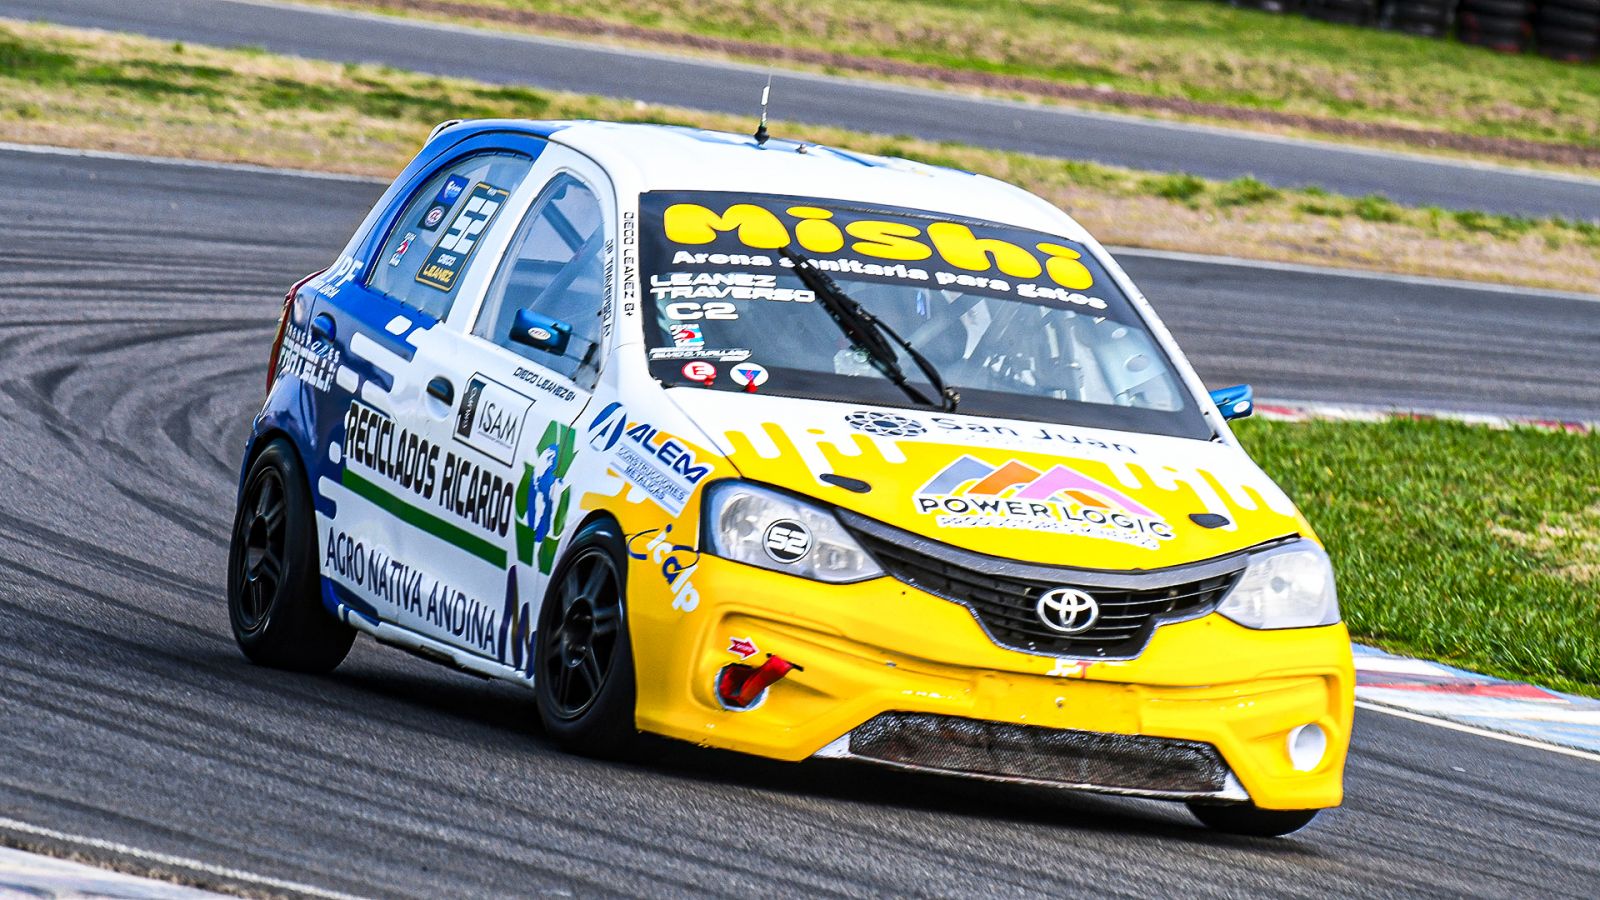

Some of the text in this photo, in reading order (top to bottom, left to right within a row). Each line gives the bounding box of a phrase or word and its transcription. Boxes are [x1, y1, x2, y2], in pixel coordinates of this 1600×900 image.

[663, 203, 1094, 290] Mishi
[623, 249, 635, 299] LEANEZ
[650, 272, 777, 287] LEANEZ
[650, 286, 816, 303] TRAVERSO
[672, 250, 1108, 310] Arena snitaria para gatos
[665, 302, 739, 320] C2
[691, 365, 706, 376] E
[478, 400, 519, 445] ISAM
[931, 417, 1018, 437] San
[1032, 429, 1137, 454] Juan
[345, 401, 440, 500] RECICLADOS
[439, 453, 514, 537] RICARDO
[626, 423, 709, 484] ALEM
[918, 497, 1048, 517] POWER
[1062, 505, 1174, 538] LOGIC
[325, 527, 496, 654] AGRO NATIVA ANDINA
